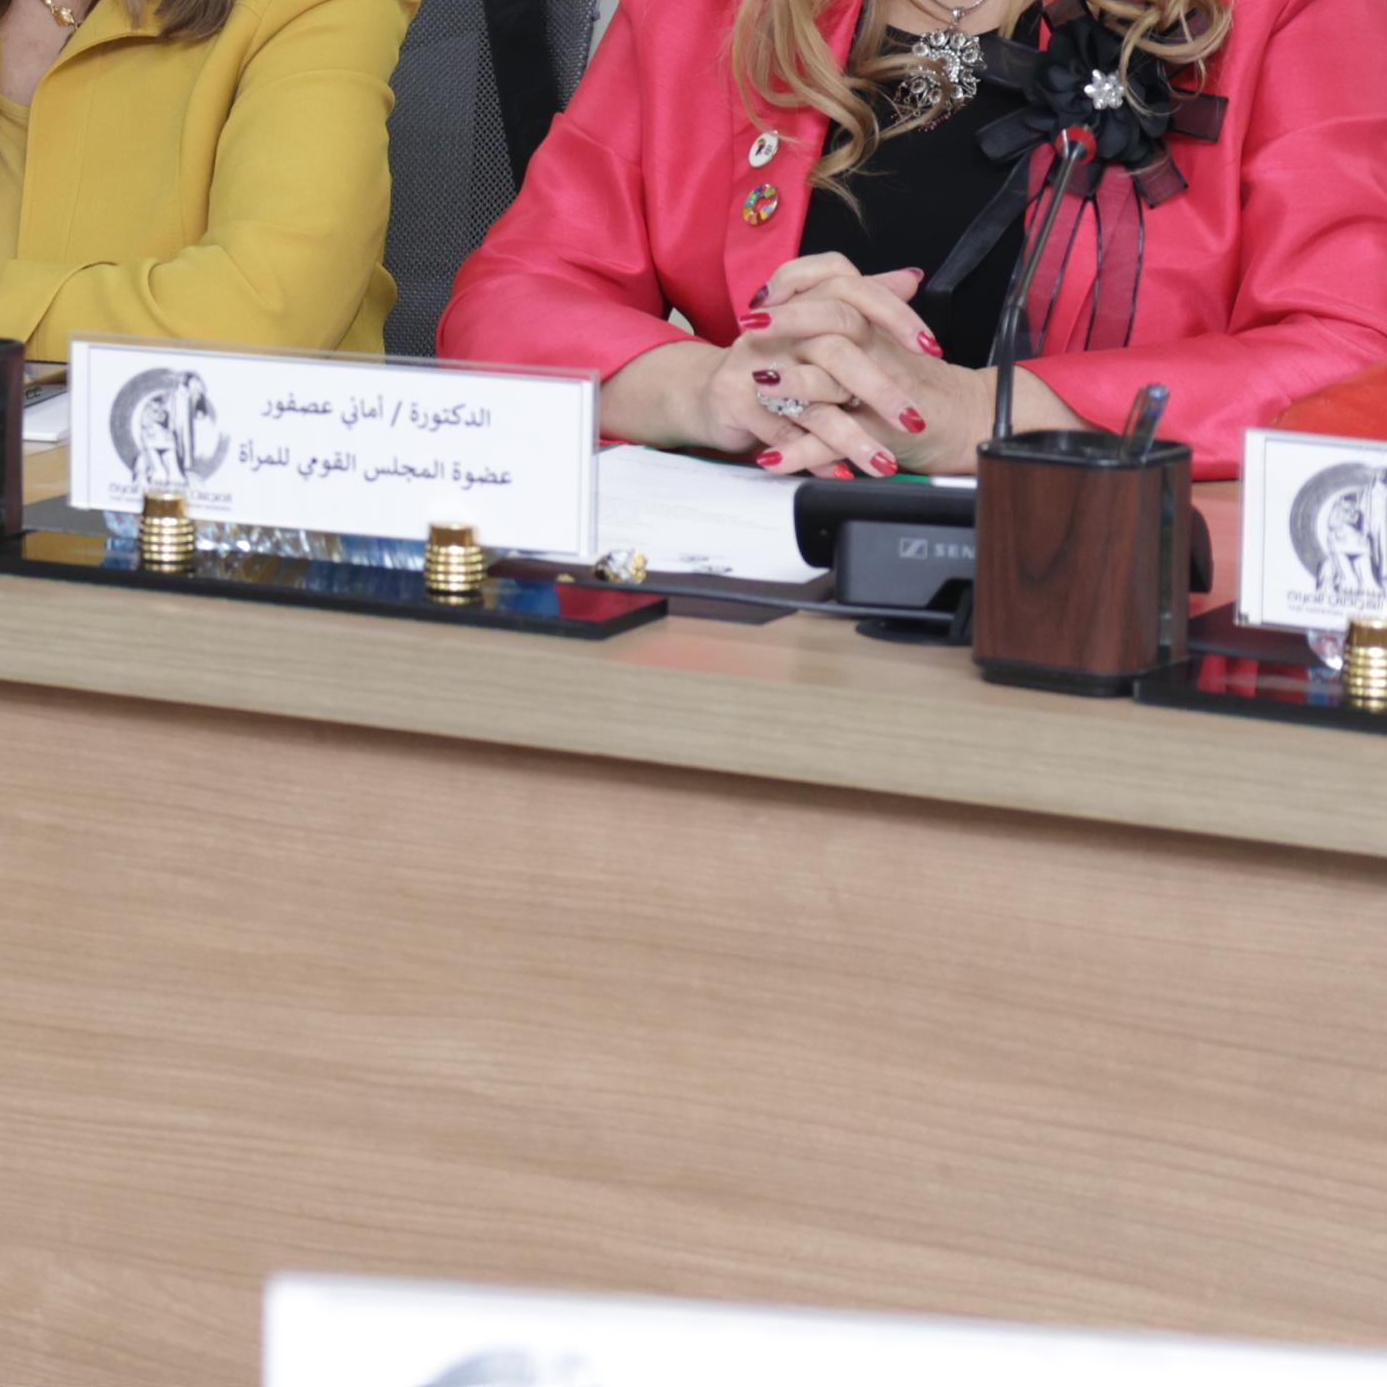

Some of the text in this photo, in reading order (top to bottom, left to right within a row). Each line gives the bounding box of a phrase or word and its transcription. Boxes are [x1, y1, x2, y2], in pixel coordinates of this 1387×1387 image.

[262, 393, 333, 419] عصفور
[341, 395, 383, 430] أماني
[410, 403, 490, 432] الدكتورة
[239, 440, 512, 491] عضوة المجلس القومي للمرأة
